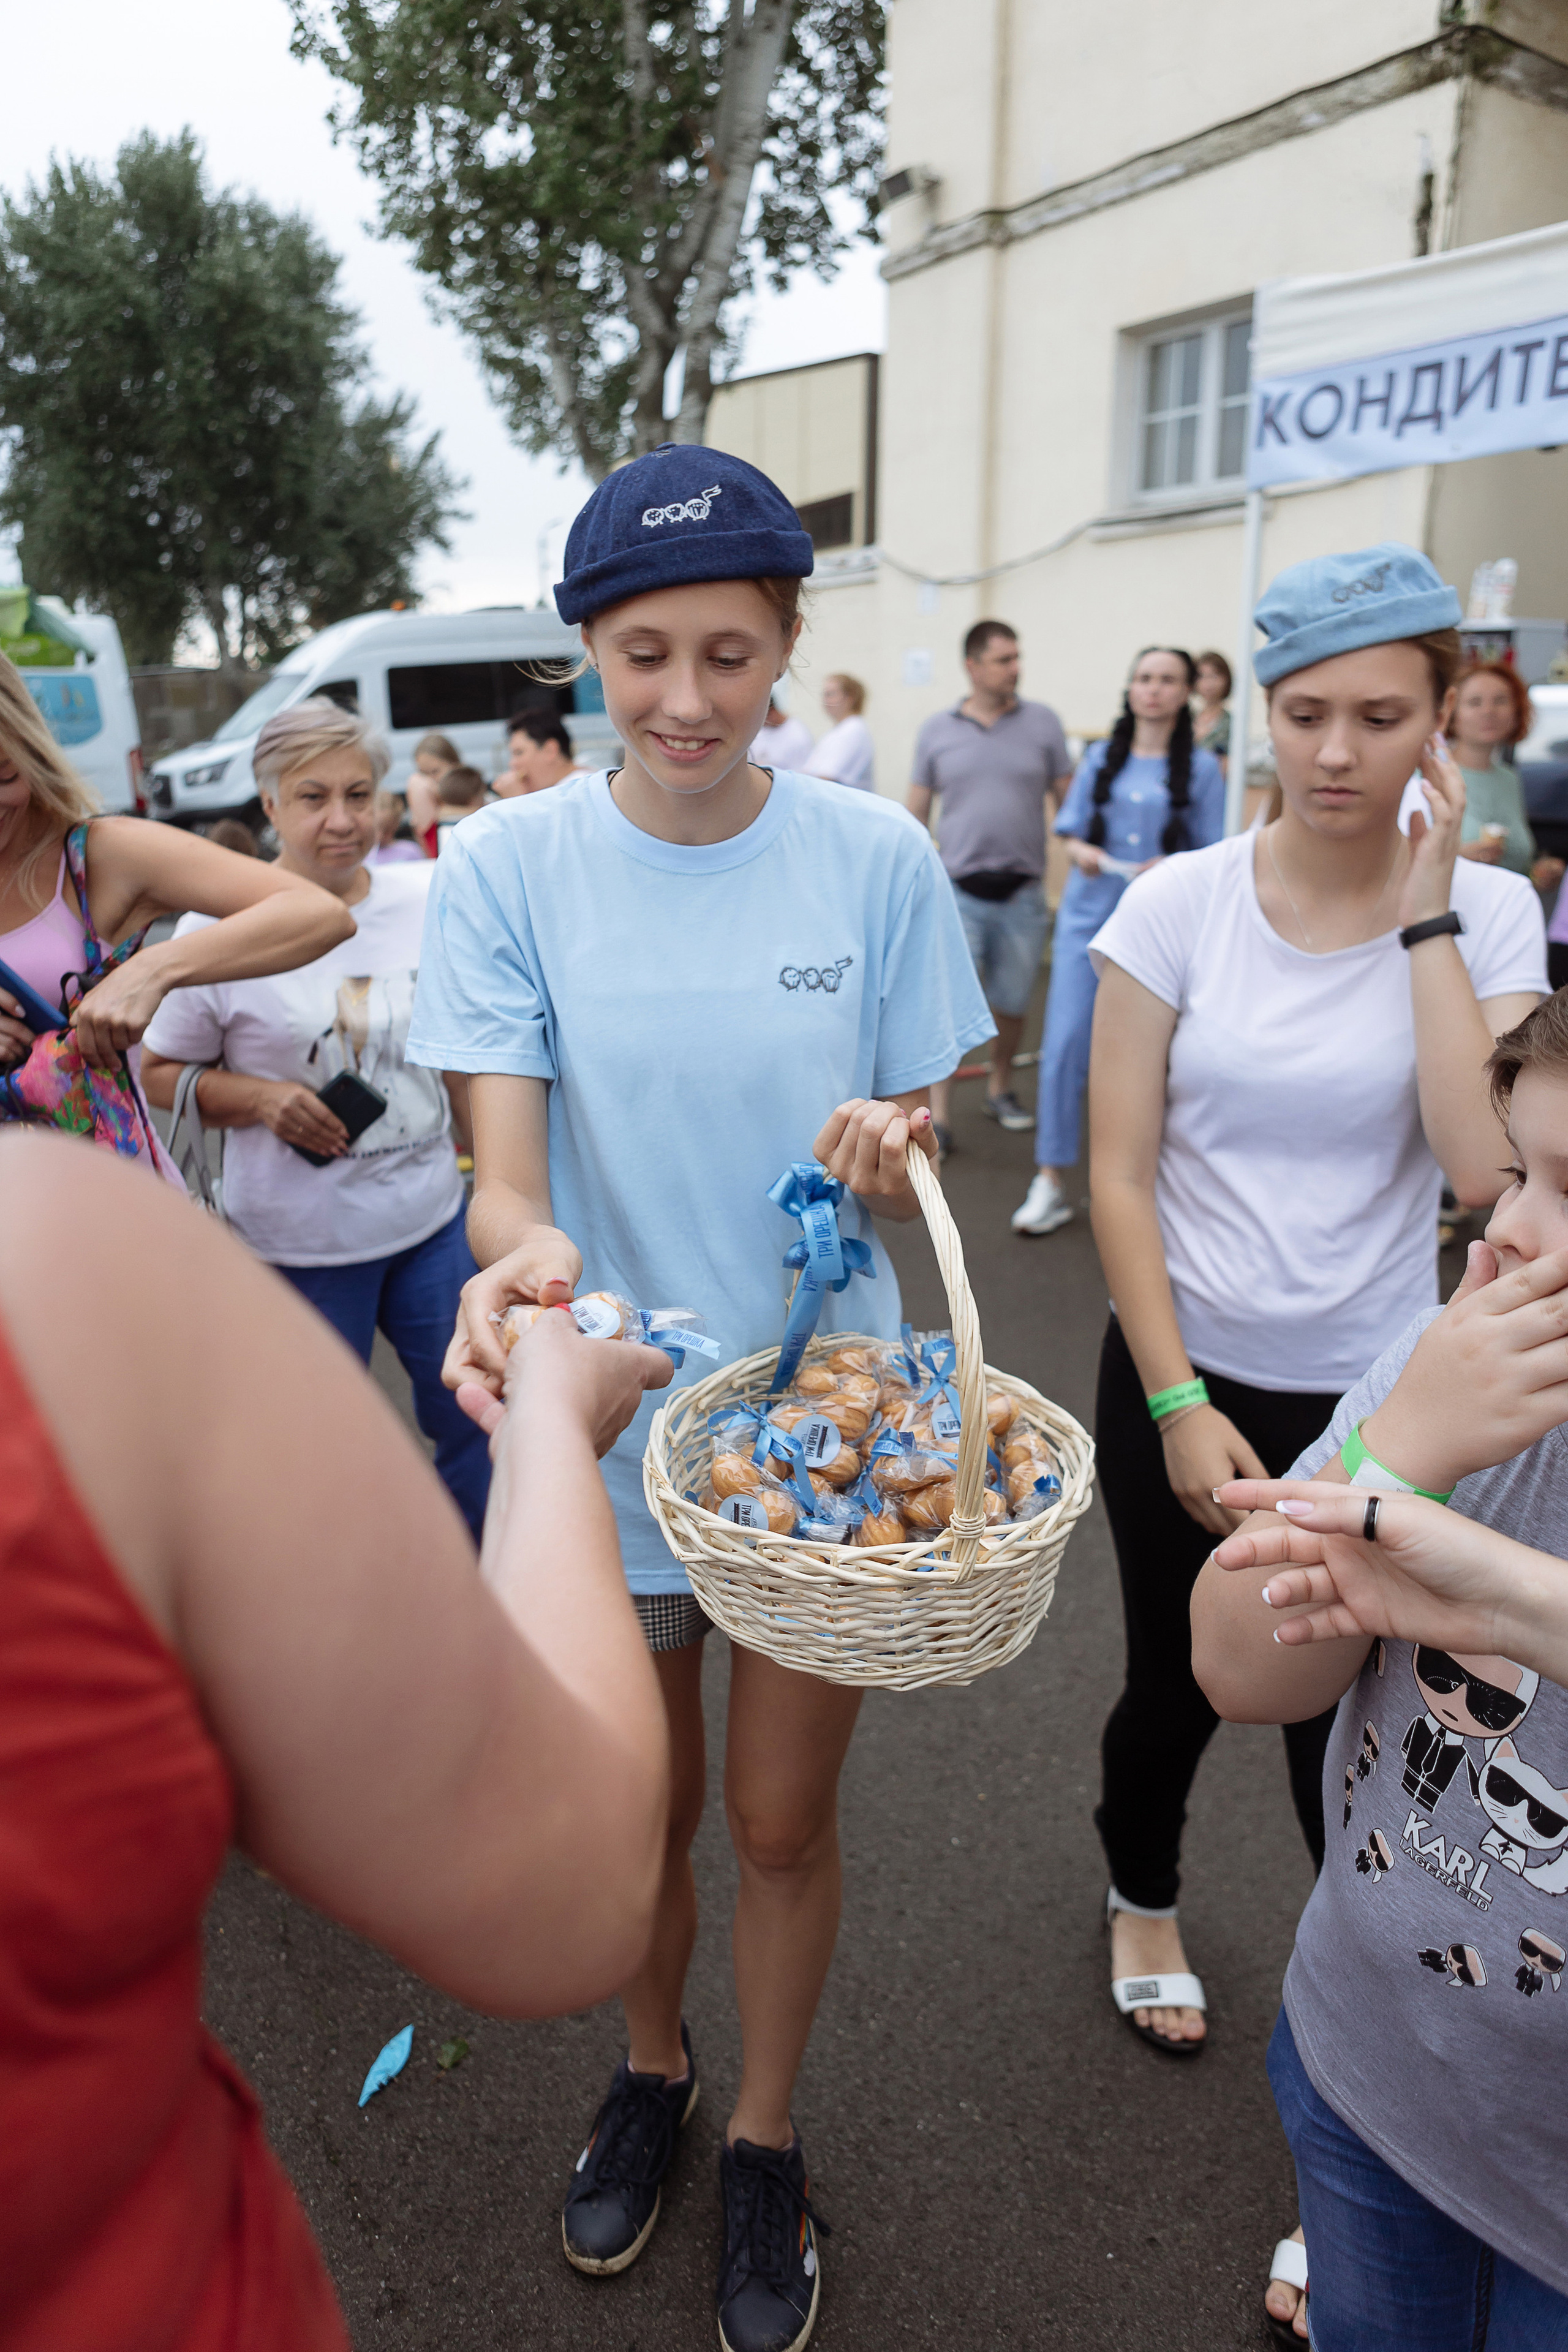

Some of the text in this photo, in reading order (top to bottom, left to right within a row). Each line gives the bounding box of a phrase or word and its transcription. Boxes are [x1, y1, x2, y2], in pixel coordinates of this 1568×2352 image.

[810, 1204, 834, 1259] ТРИ ОРЕШКА
[671, 1331, 706, 1349] ТРИ ОРЕШКА
[805, 1423, 821, 1457] ТРИ ОРЕШКА
[741, 1504, 752, 1516] ТРИ
[1399, 1837, 1489, 1912] LAGERFELD
[1401, 1808, 1494, 1904] KARL
